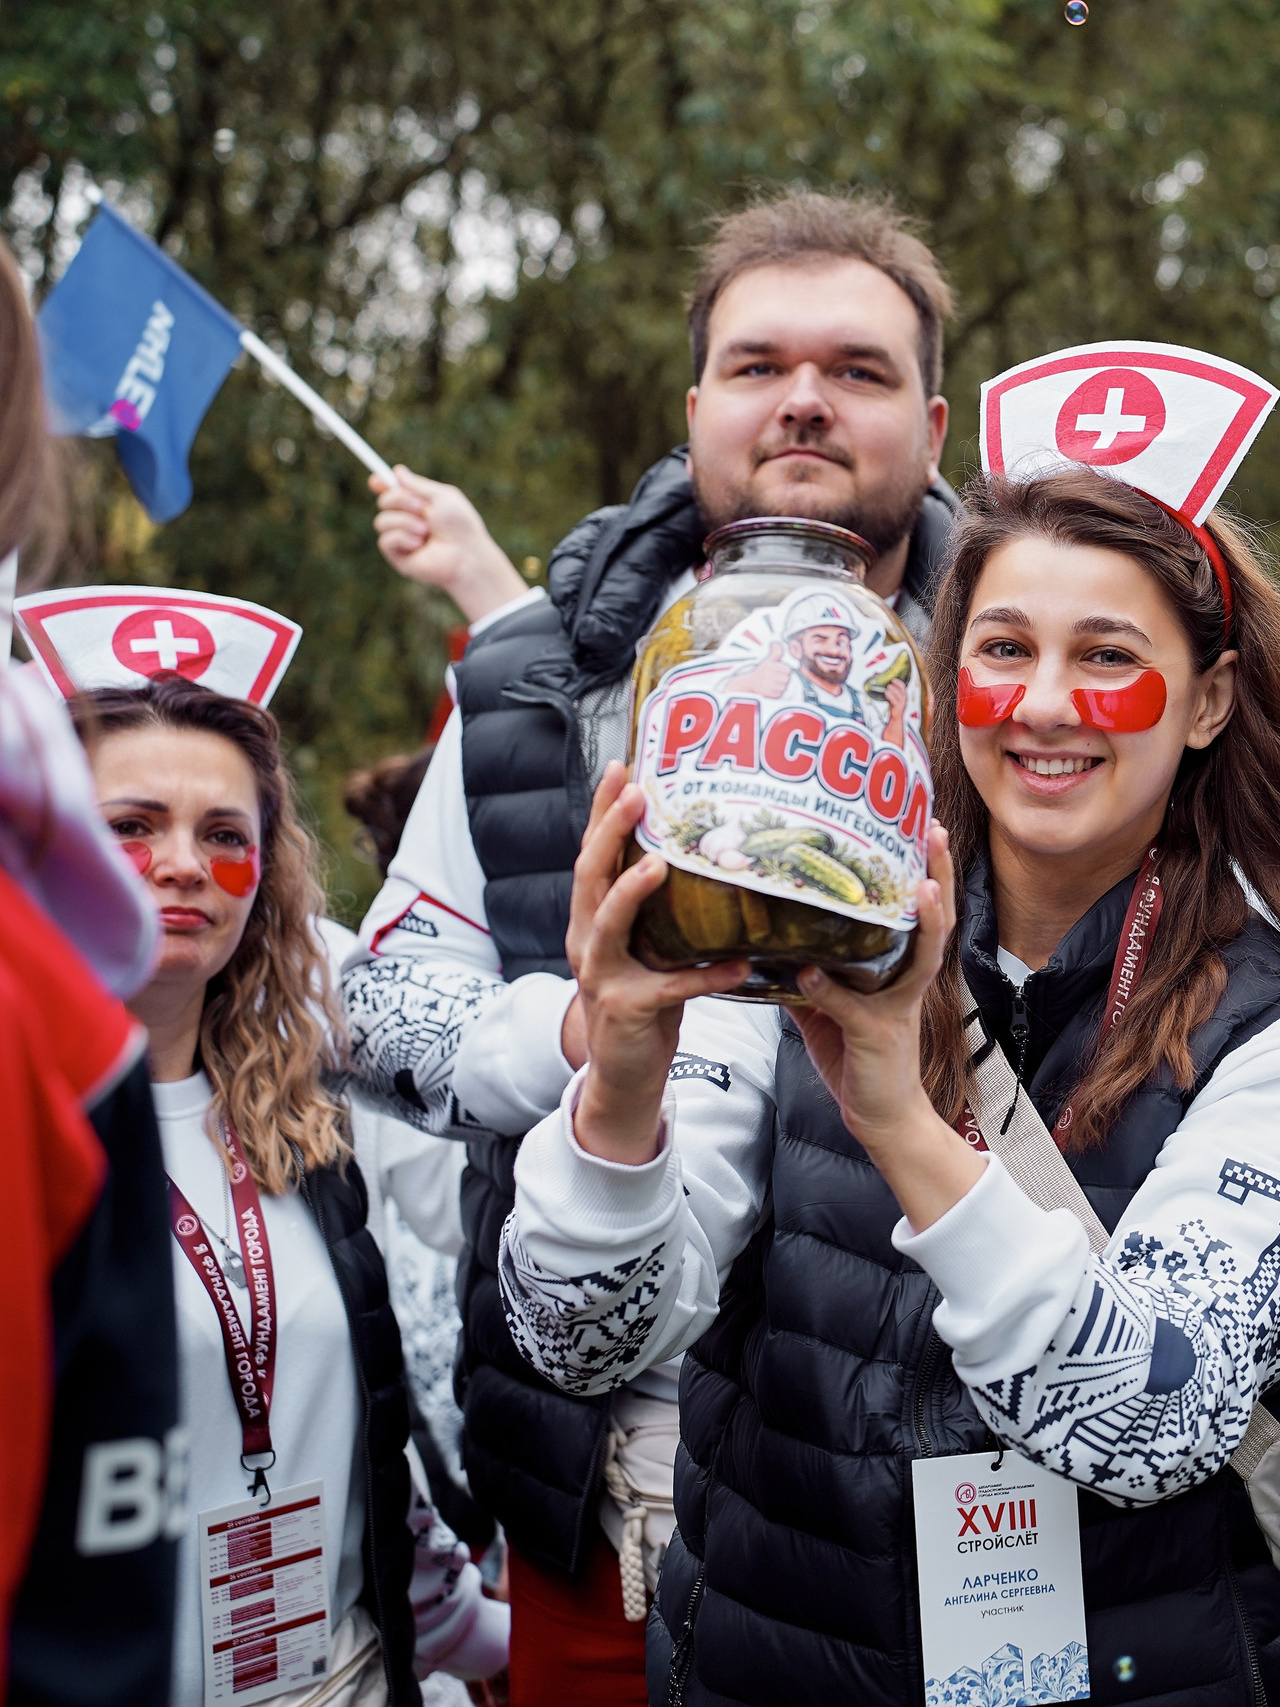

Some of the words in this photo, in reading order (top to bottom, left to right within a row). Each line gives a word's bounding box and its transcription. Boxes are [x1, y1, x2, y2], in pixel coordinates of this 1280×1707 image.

[656, 694, 929, 842] РАССОЛ
[815, 796, 905, 863] ИНГЕОКОМ
[1117, 889, 1156, 1000] ФУНДАМЕНТ
[241, 1206, 266, 1266] ГОРОДА
[193, 1243, 209, 1255] Я
[202, 1255, 246, 1349] ФУНДАМЕНТ
[235, 1352, 262, 1419] ГОРОДА
[253, 1268, 272, 1366] ФУНДАМЕНТ
[957, 1499, 1037, 1537] XVIII
[957, 1531, 1039, 1554] СТРОЙСЛЁТ
[944, 1591, 998, 1607] АНГЕЛИНА
[1001, 1584, 1056, 1600] СЕРГЕЕВНА
[962, 1568, 1039, 1589] ЛАРЧЕНКО
[981, 1604, 1024, 1619] участник
